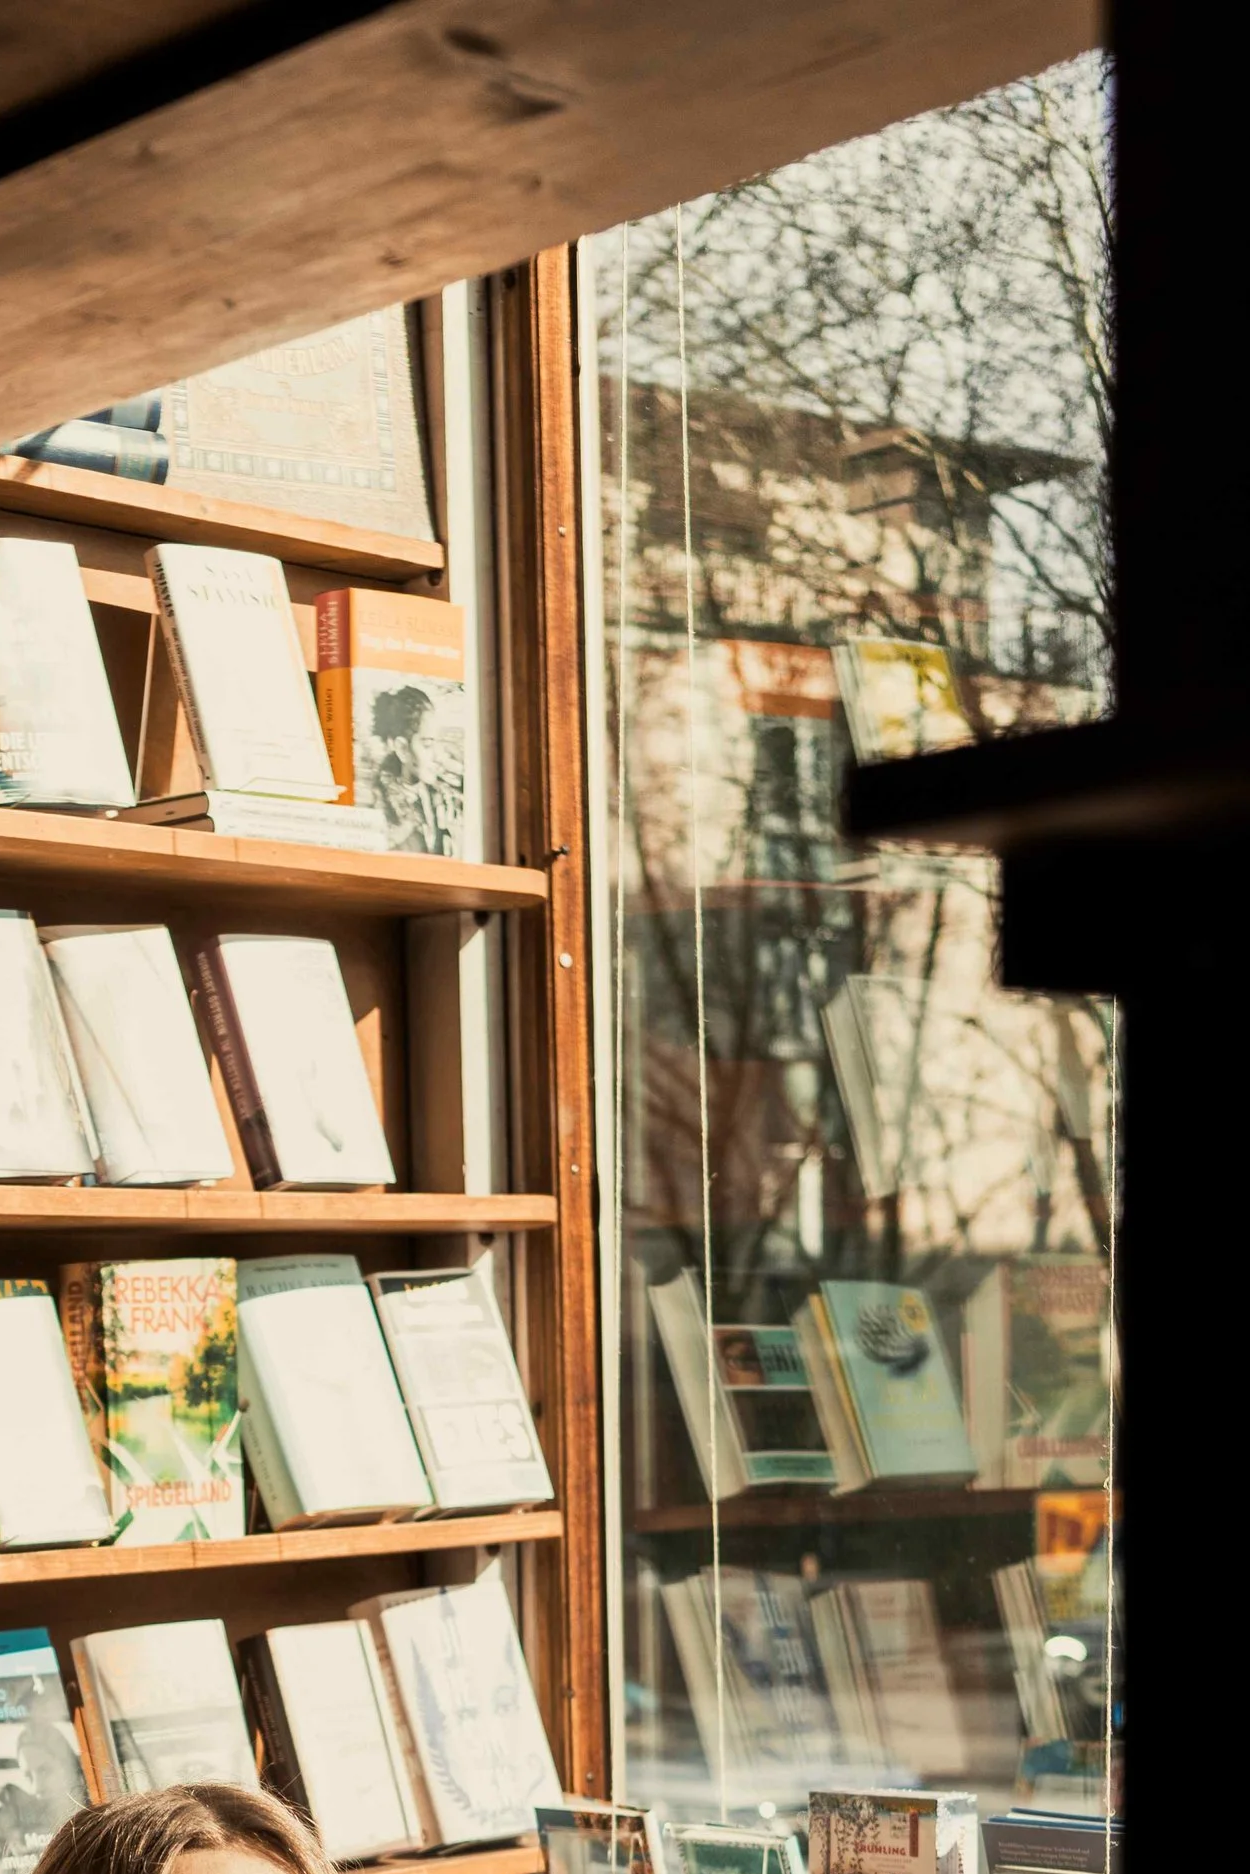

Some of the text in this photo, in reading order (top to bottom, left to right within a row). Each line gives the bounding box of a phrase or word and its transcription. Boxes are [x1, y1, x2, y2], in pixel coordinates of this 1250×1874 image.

[114, 1274, 221, 1305] REBEKKA
[130, 1307, 208, 1334] FRANK
[125, 1479, 232, 1510] SPIEGELLAND
